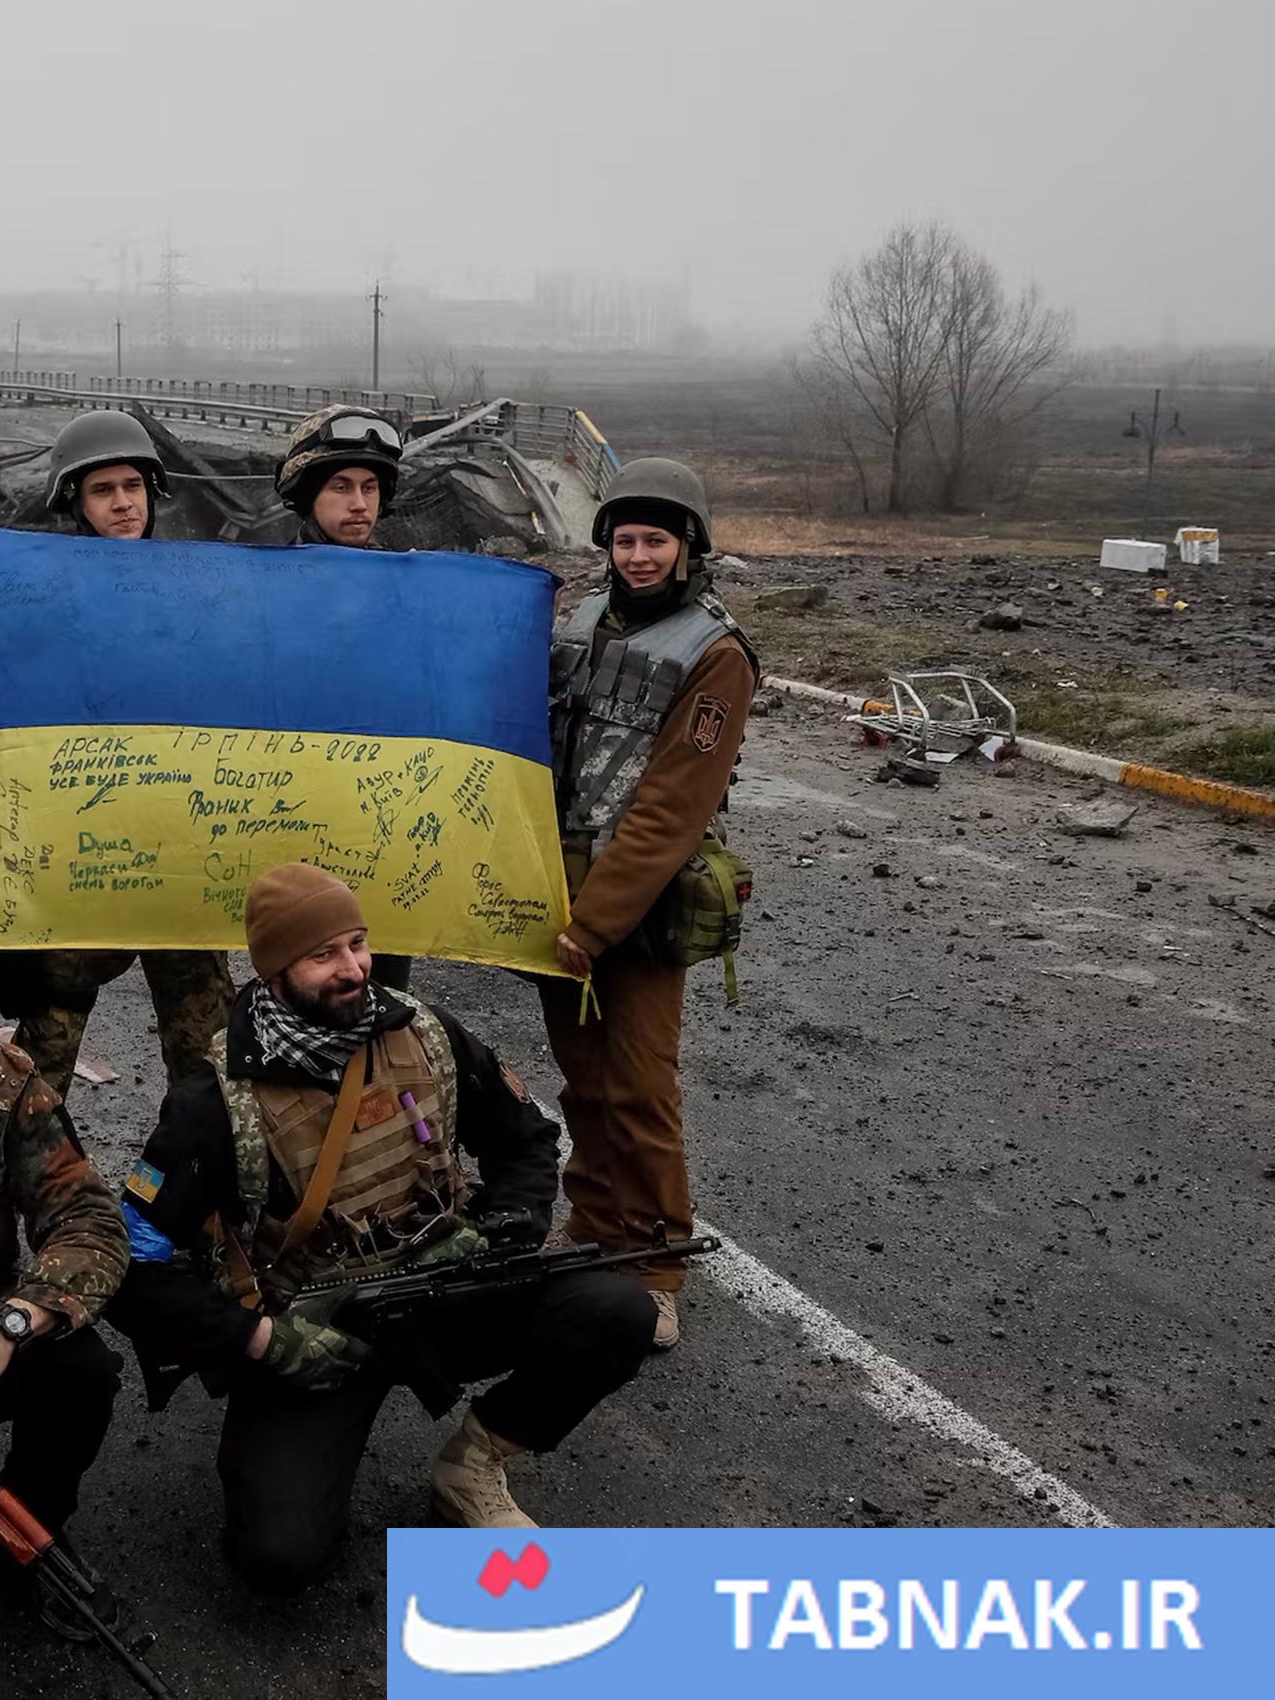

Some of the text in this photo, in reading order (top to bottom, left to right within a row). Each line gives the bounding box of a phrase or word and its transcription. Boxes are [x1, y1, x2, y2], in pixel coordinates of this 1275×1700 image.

[53, 736, 133, 760] АРСАК
[50, 776, 78, 790] УСЕ
[86, 773, 129, 788] БУДЕ
[78, 831, 133, 859] Душа
